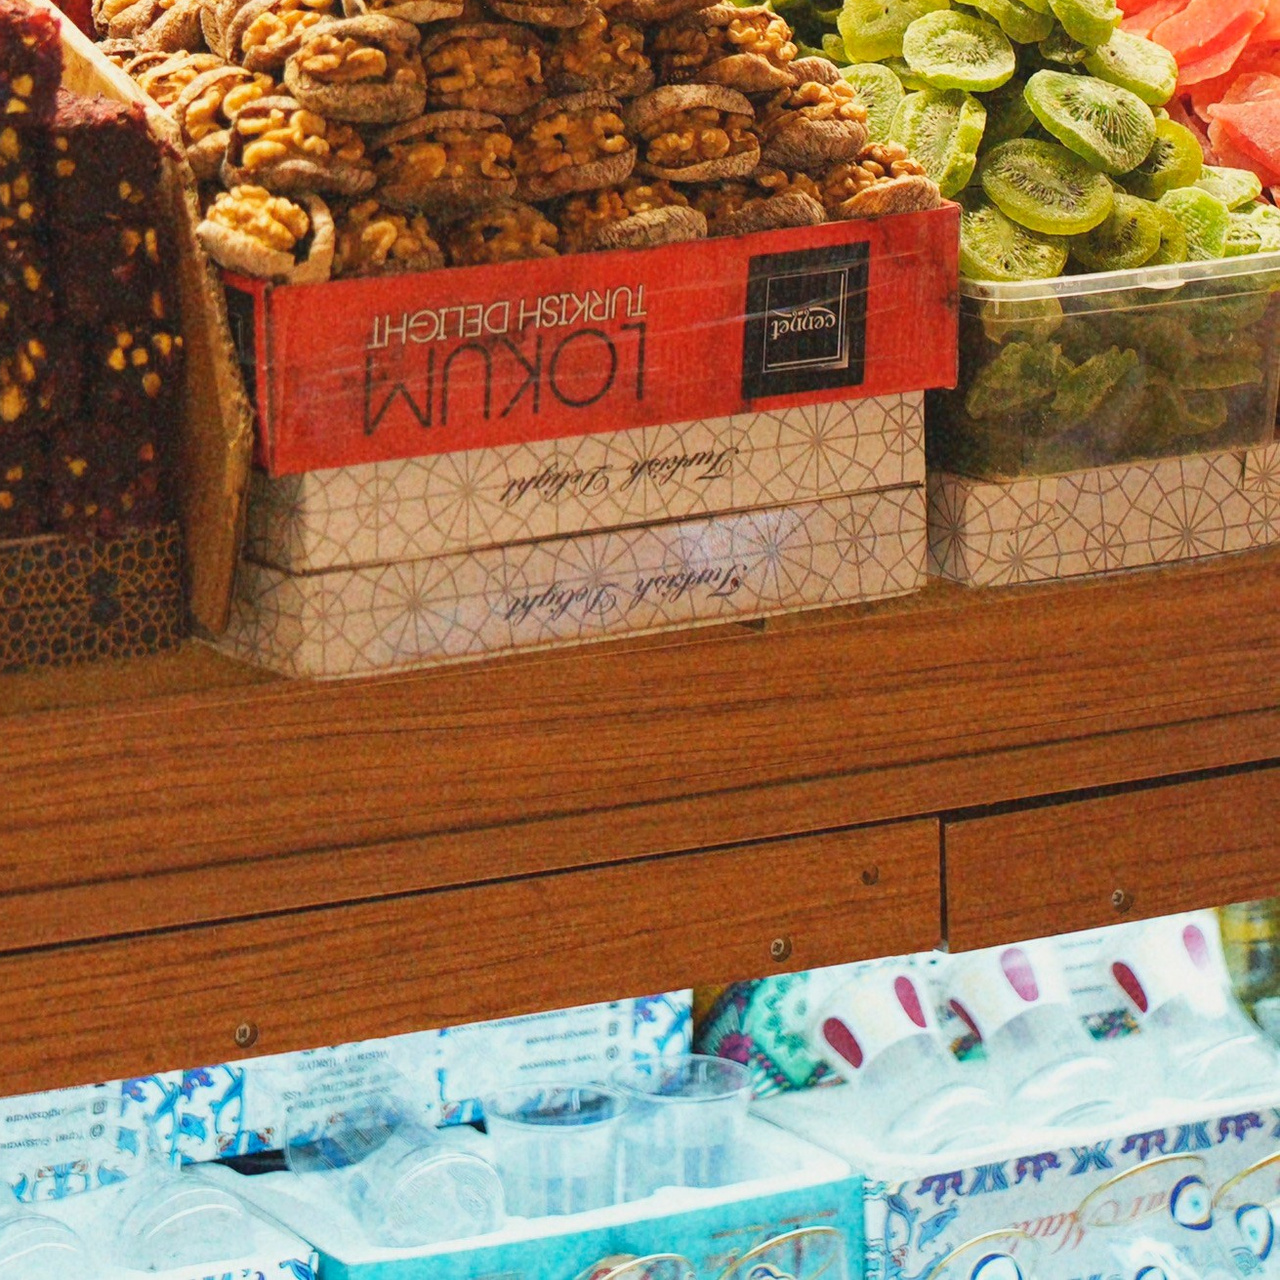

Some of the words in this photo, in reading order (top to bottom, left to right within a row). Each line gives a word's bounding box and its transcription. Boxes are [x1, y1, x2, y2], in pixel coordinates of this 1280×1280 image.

[366, 300, 510, 350] DELIGHT
[519, 284, 648, 331] TURKISH
[363, 321, 647, 437] LOKUM
[499, 461, 615, 508] Delight
[620, 446, 740, 492] Turkish
[504, 580, 620, 627] Delight
[629, 563, 748, 610] Turkish
